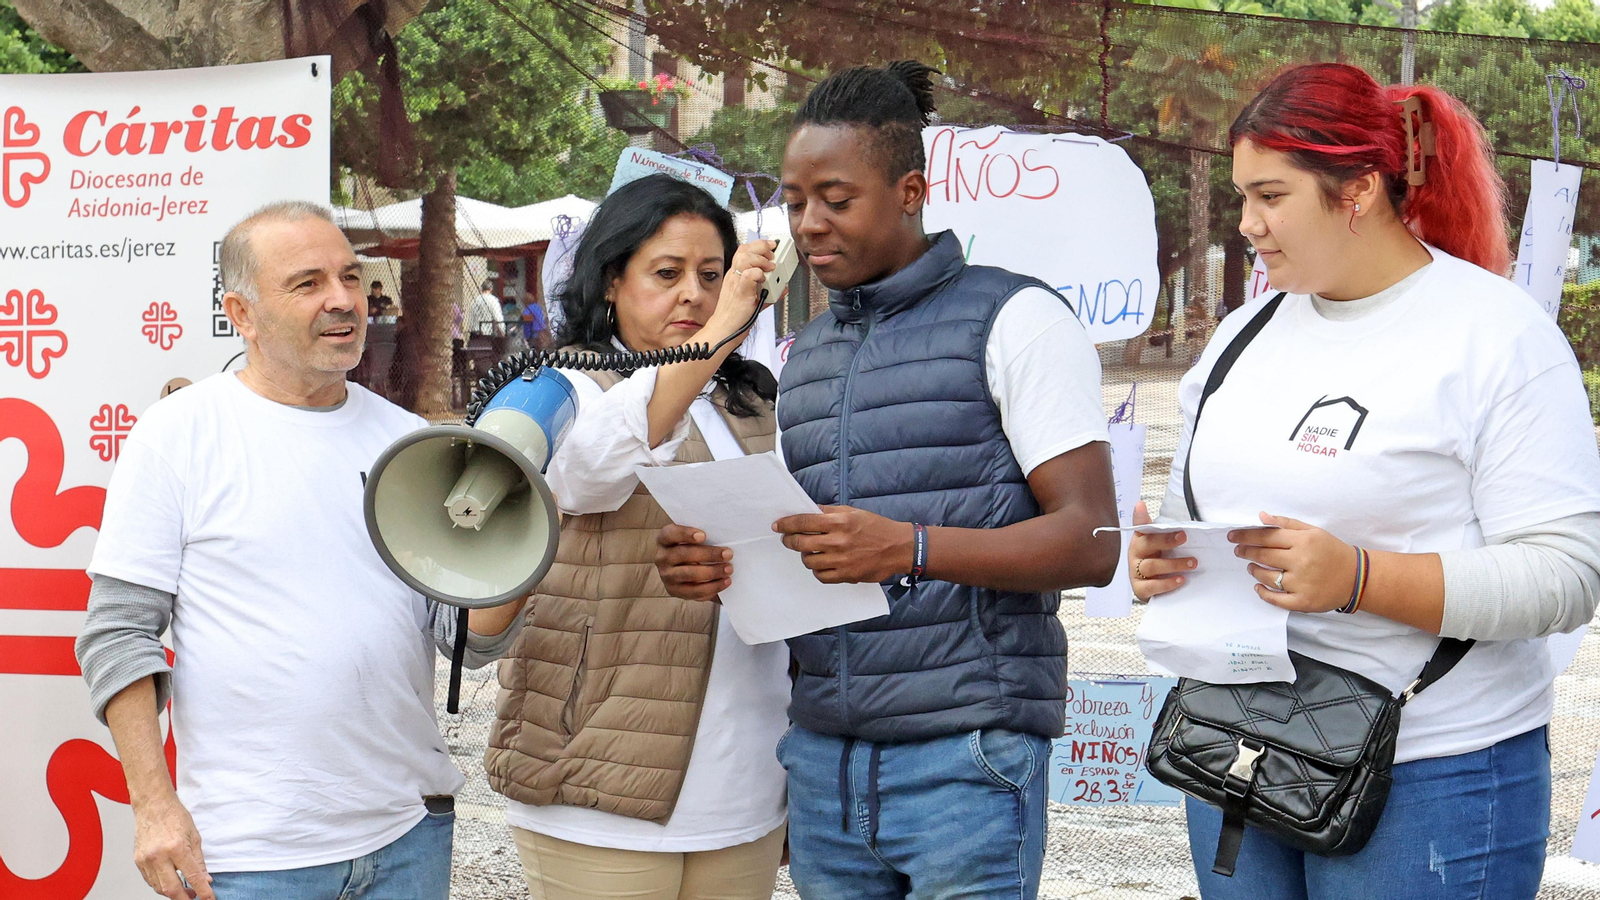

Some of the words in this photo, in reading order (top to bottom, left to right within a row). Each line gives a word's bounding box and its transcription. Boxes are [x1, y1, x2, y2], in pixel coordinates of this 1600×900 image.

[63, 105, 312, 157] Cáritas
[926, 128, 1059, 205] AÑOS
[70, 168, 172, 190] Diocesana
[180, 165, 204, 186] de
[68, 195, 209, 221] Asidonia-Jerez
[1301, 433, 1319, 442] SIN
[1305, 426, 1338, 437] NADIE
[1296, 442, 1337, 458] HOGAR
[1061, 767, 1074, 775] en
[1081, 766, 1120, 777] ESPAÑA
